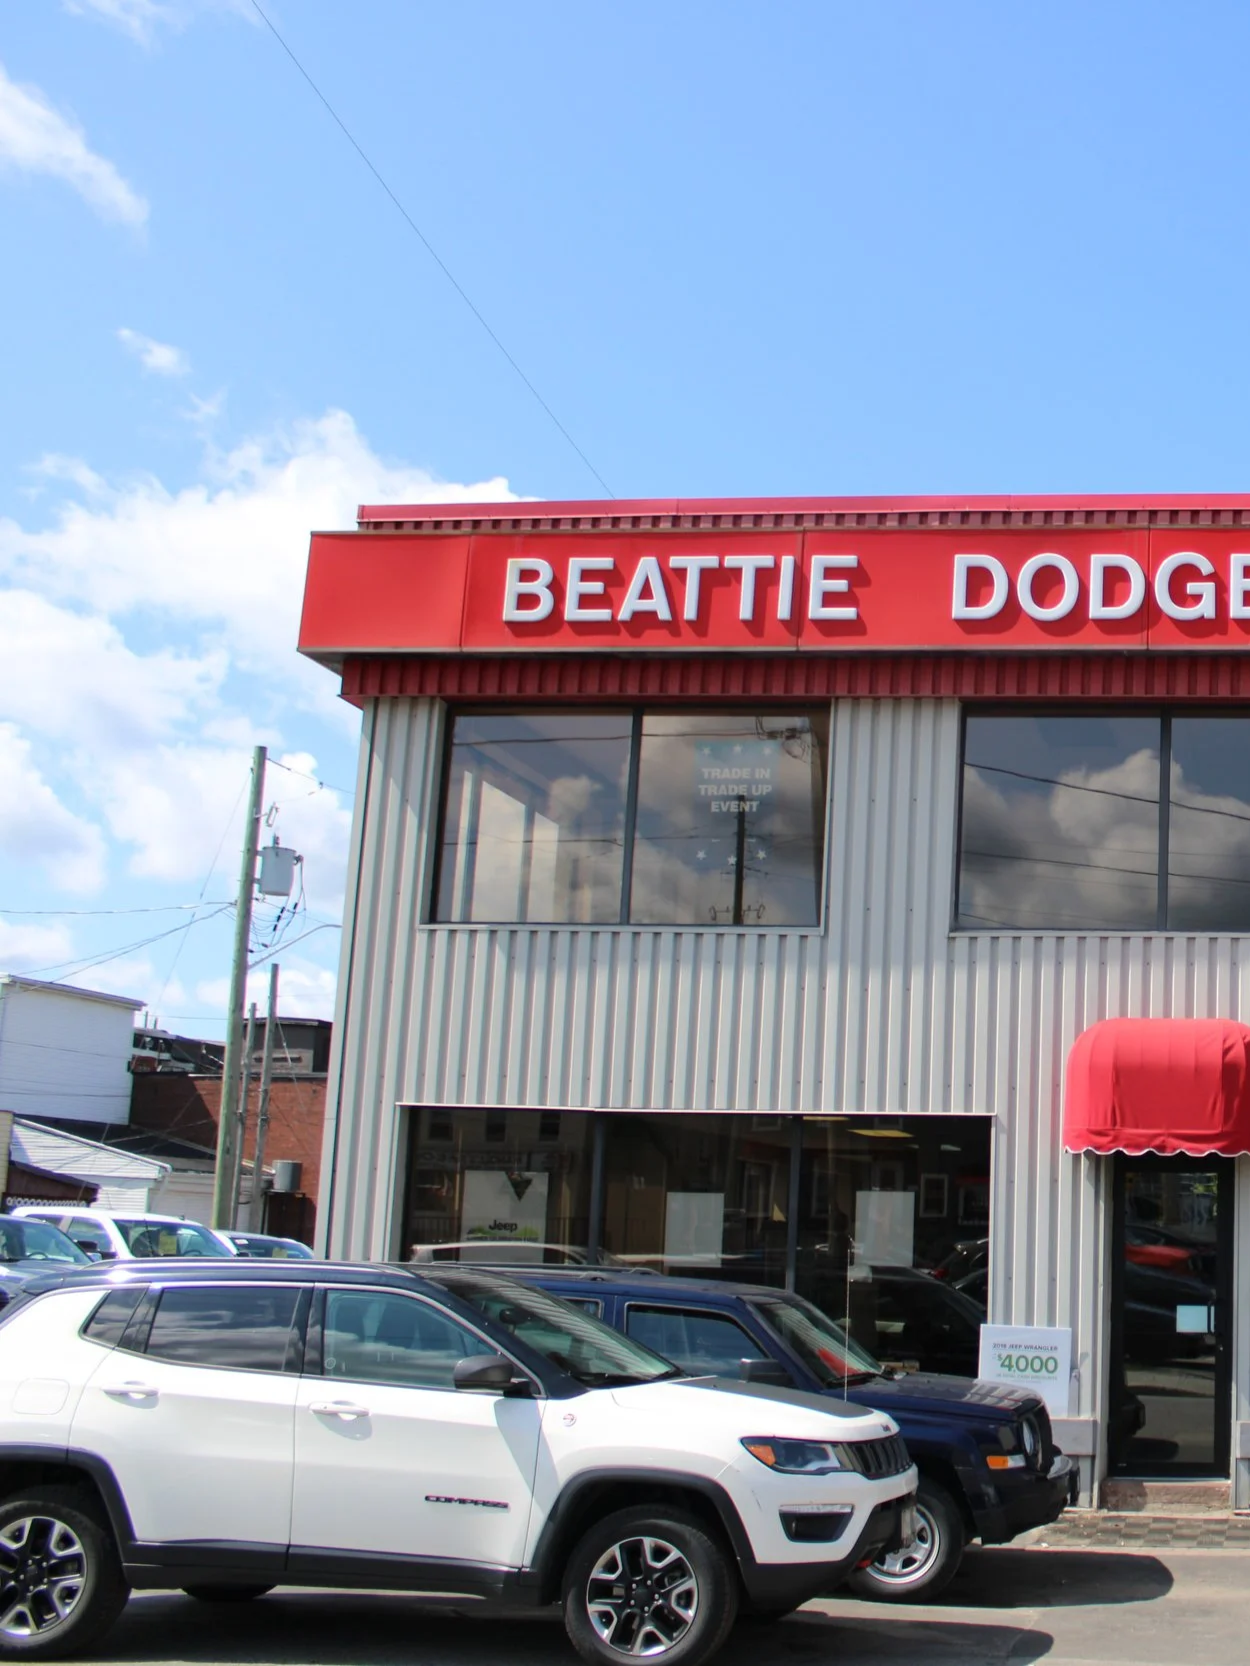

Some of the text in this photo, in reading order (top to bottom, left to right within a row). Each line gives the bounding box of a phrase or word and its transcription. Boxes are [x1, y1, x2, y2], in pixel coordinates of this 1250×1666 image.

[501, 555, 860, 623] BEATTIE
[701, 768, 771, 779] TRADE IN
[698, 784, 772, 796] TRADE UP
[710, 801, 760, 813] EVENT
[488, 1219, 518, 1233] Jeep
